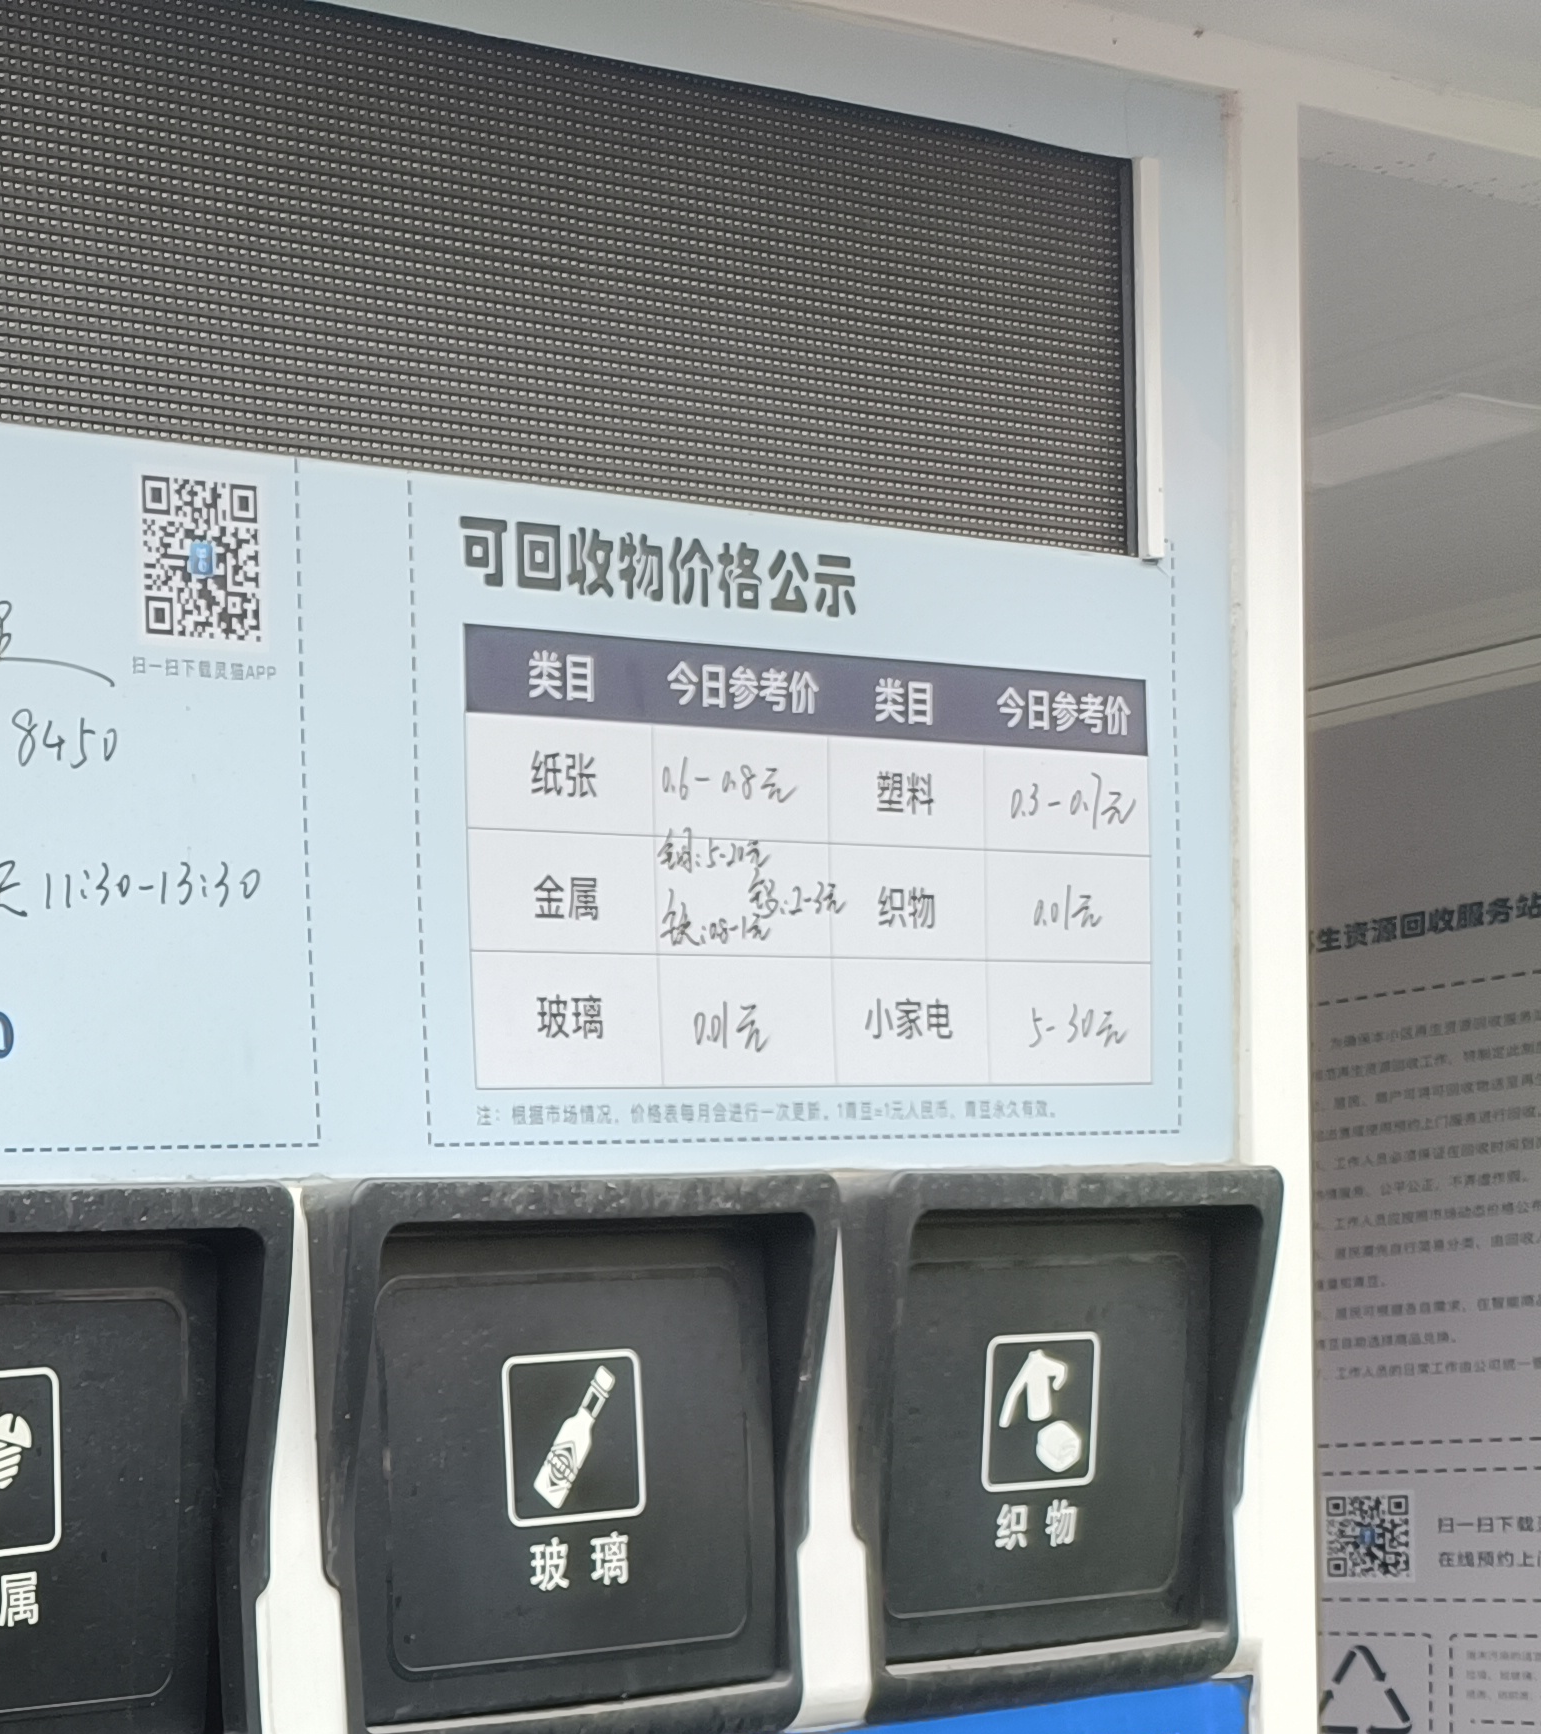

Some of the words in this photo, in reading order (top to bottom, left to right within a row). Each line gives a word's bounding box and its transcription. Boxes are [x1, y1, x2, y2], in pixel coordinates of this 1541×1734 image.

[459, 515, 857, 618] 可回收物价格公示
[528, 650, 596, 703] 类目
[667, 661, 819, 716] 今日参考价
[875, 677, 934, 726] 类目
[996, 686, 1131, 737] 今日参考价
[530, 750, 597, 800] 纸张
[876, 770, 935, 817] 塑料
[534, 875, 599, 923] 金属
[877, 886, 936, 930] 织物
[537, 995, 605, 1041] 玻璃
[864, 998, 954, 1042] 小家电
[995, 1498, 1077, 1552] 织物
[1438, 1515, 1541, 1534] 扫一扫下载
[529, 1531, 630, 1592] 玻璃
[1439, 1550, 1541, 1569] 在线预约上
